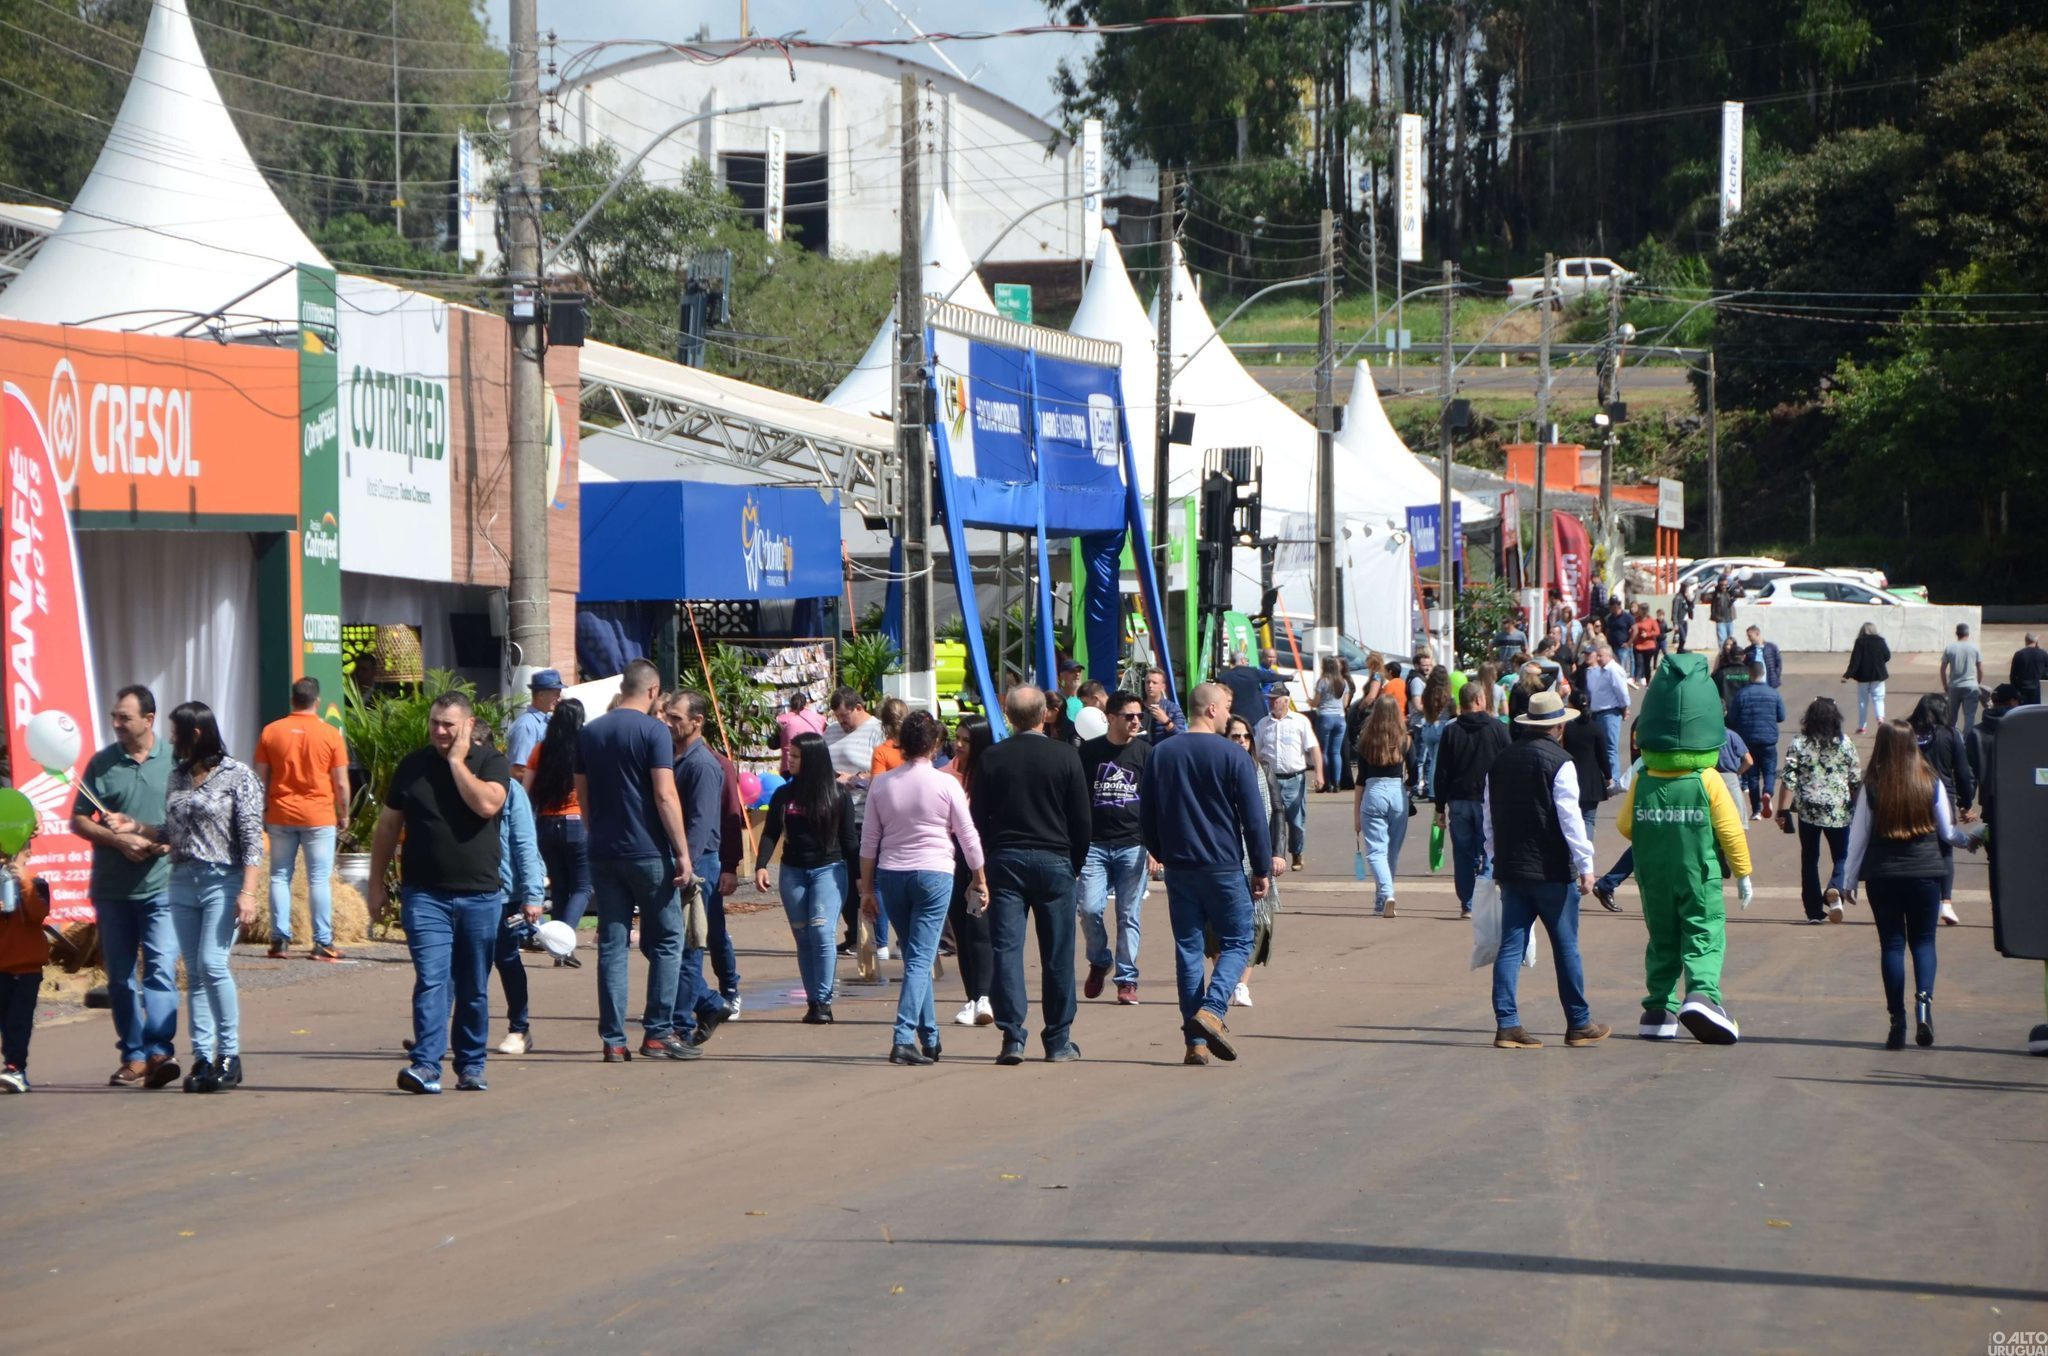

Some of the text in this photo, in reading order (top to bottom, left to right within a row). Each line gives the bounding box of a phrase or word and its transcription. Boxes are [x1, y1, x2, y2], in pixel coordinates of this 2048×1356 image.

[1404, 125, 1414, 211] STEMETAL
[89, 382, 201, 478] CRESOL
[350, 363, 445, 462] COTRIFRED
[29, 456, 48, 615] MOTOS
[9, 446, 41, 730] PANAFÉ
[303, 613, 339, 641] COTRIFRED
[1093, 780, 1138, 793] Expofred
